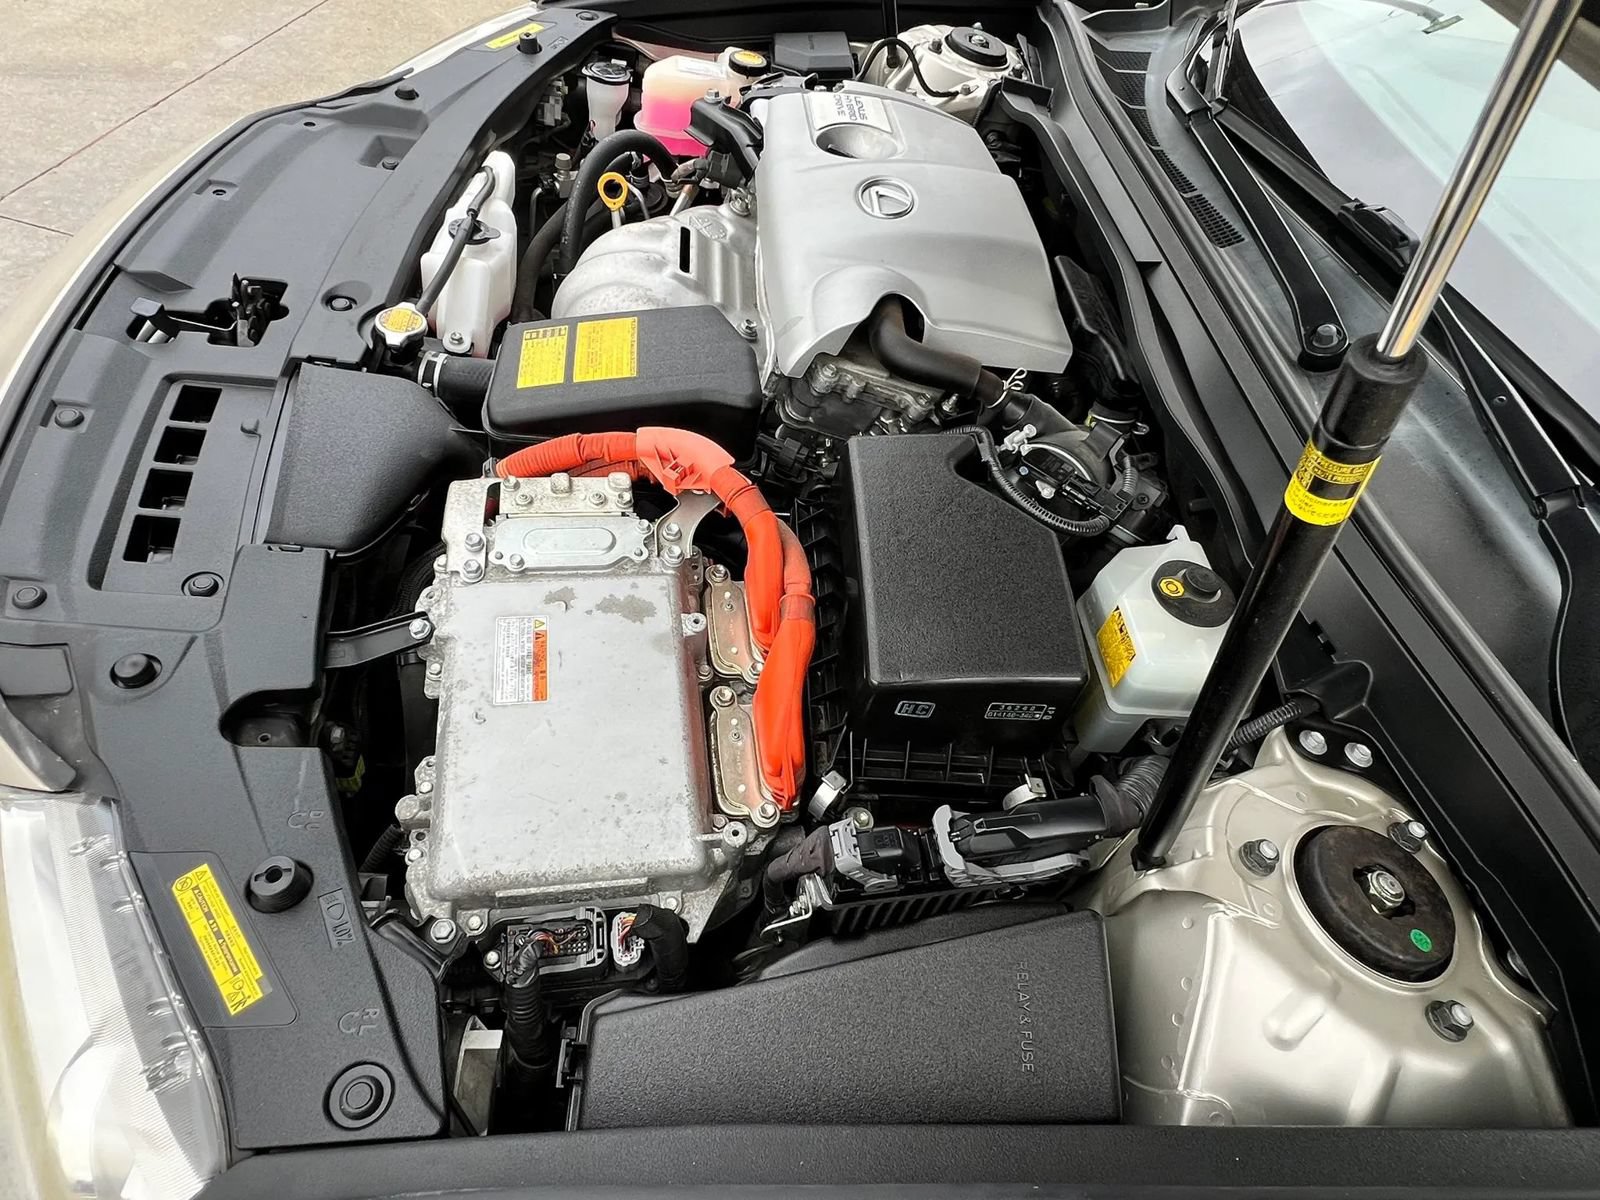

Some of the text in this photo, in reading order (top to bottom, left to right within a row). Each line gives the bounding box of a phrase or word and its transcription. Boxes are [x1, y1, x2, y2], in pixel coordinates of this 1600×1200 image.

[901, 703, 929, 716] HC
[1016, 961, 1035, 1073] RELAY & FUSE
